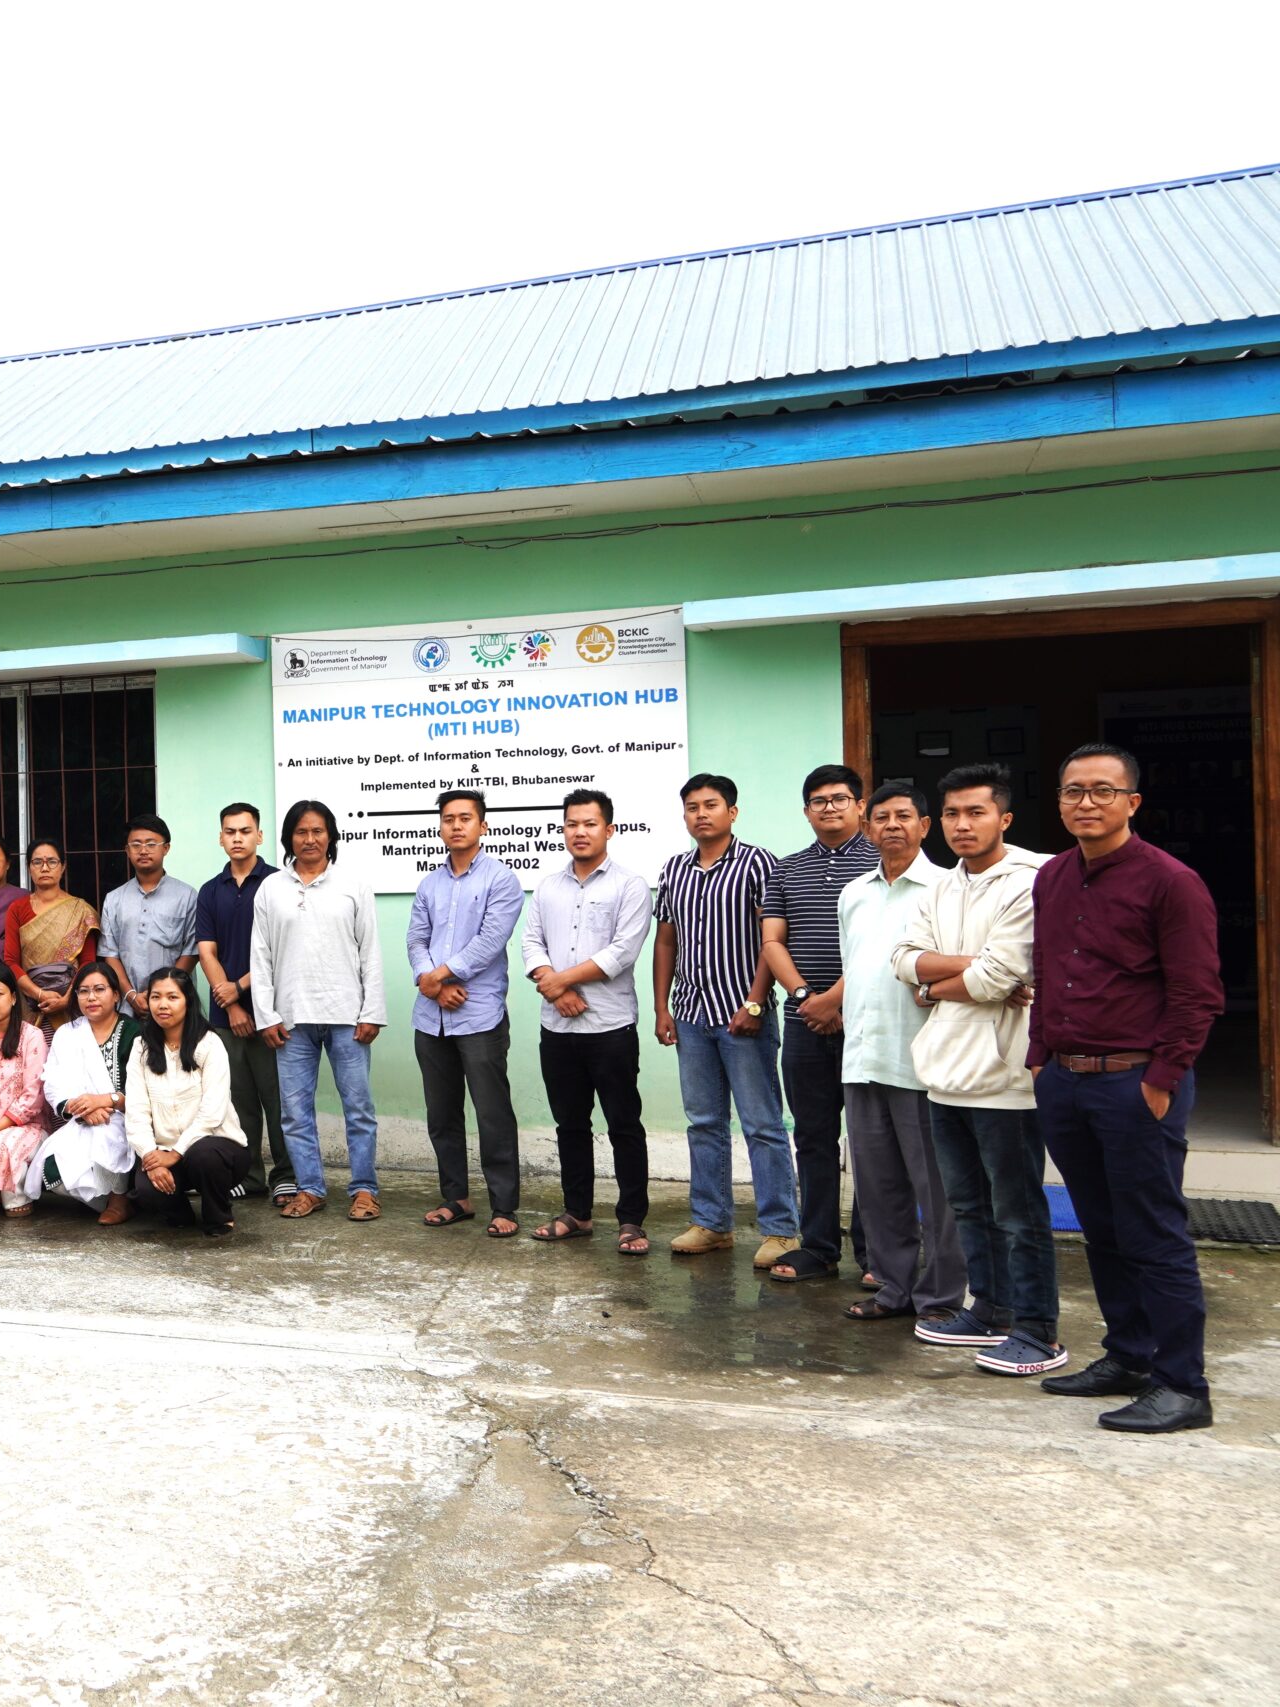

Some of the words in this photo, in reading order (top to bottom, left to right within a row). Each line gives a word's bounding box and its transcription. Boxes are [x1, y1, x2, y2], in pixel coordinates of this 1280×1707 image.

[618, 628, 649, 637] BCKIC
[311, 649, 348, 657] Department
[311, 657, 348, 665] Information
[311, 665, 350, 673] Government
[283, 706, 366, 724] MANIPUR
[372, 698, 501, 719] TECHNOLOGY
[507, 690, 628, 712] INNOVATION
[635, 688, 679, 705] HUB
[428, 722, 467, 741] (MTI
[473, 718, 520, 736] HUB)
[288, 758, 303, 768] An
[306, 756, 354, 767] initiative
[357, 755, 370, 766] by
[375, 754, 405, 765] Dept.
[408, 753, 420, 762] of
[424, 750, 491, 762] Information
[495, 747, 568, 759] Technology,
[572, 744, 604, 755] Govt.
[608, 743, 621, 752] of
[625, 741, 677, 753] Manipur
[471, 764, 480, 773] &
[361, 780, 436, 793] Implemented
[440, 779, 453, 790] by
[457, 777, 508, 789] KIIT-TBI,
[512, 774, 595, 786] Bhubaneswar
[373, 827, 441, 840] Informati
[547, 823, 565, 835] Pa
[382, 844, 450, 858] Mantripuk
[534, 840, 566, 852] Wes
[1017, 1364, 1044, 1372] crocs
